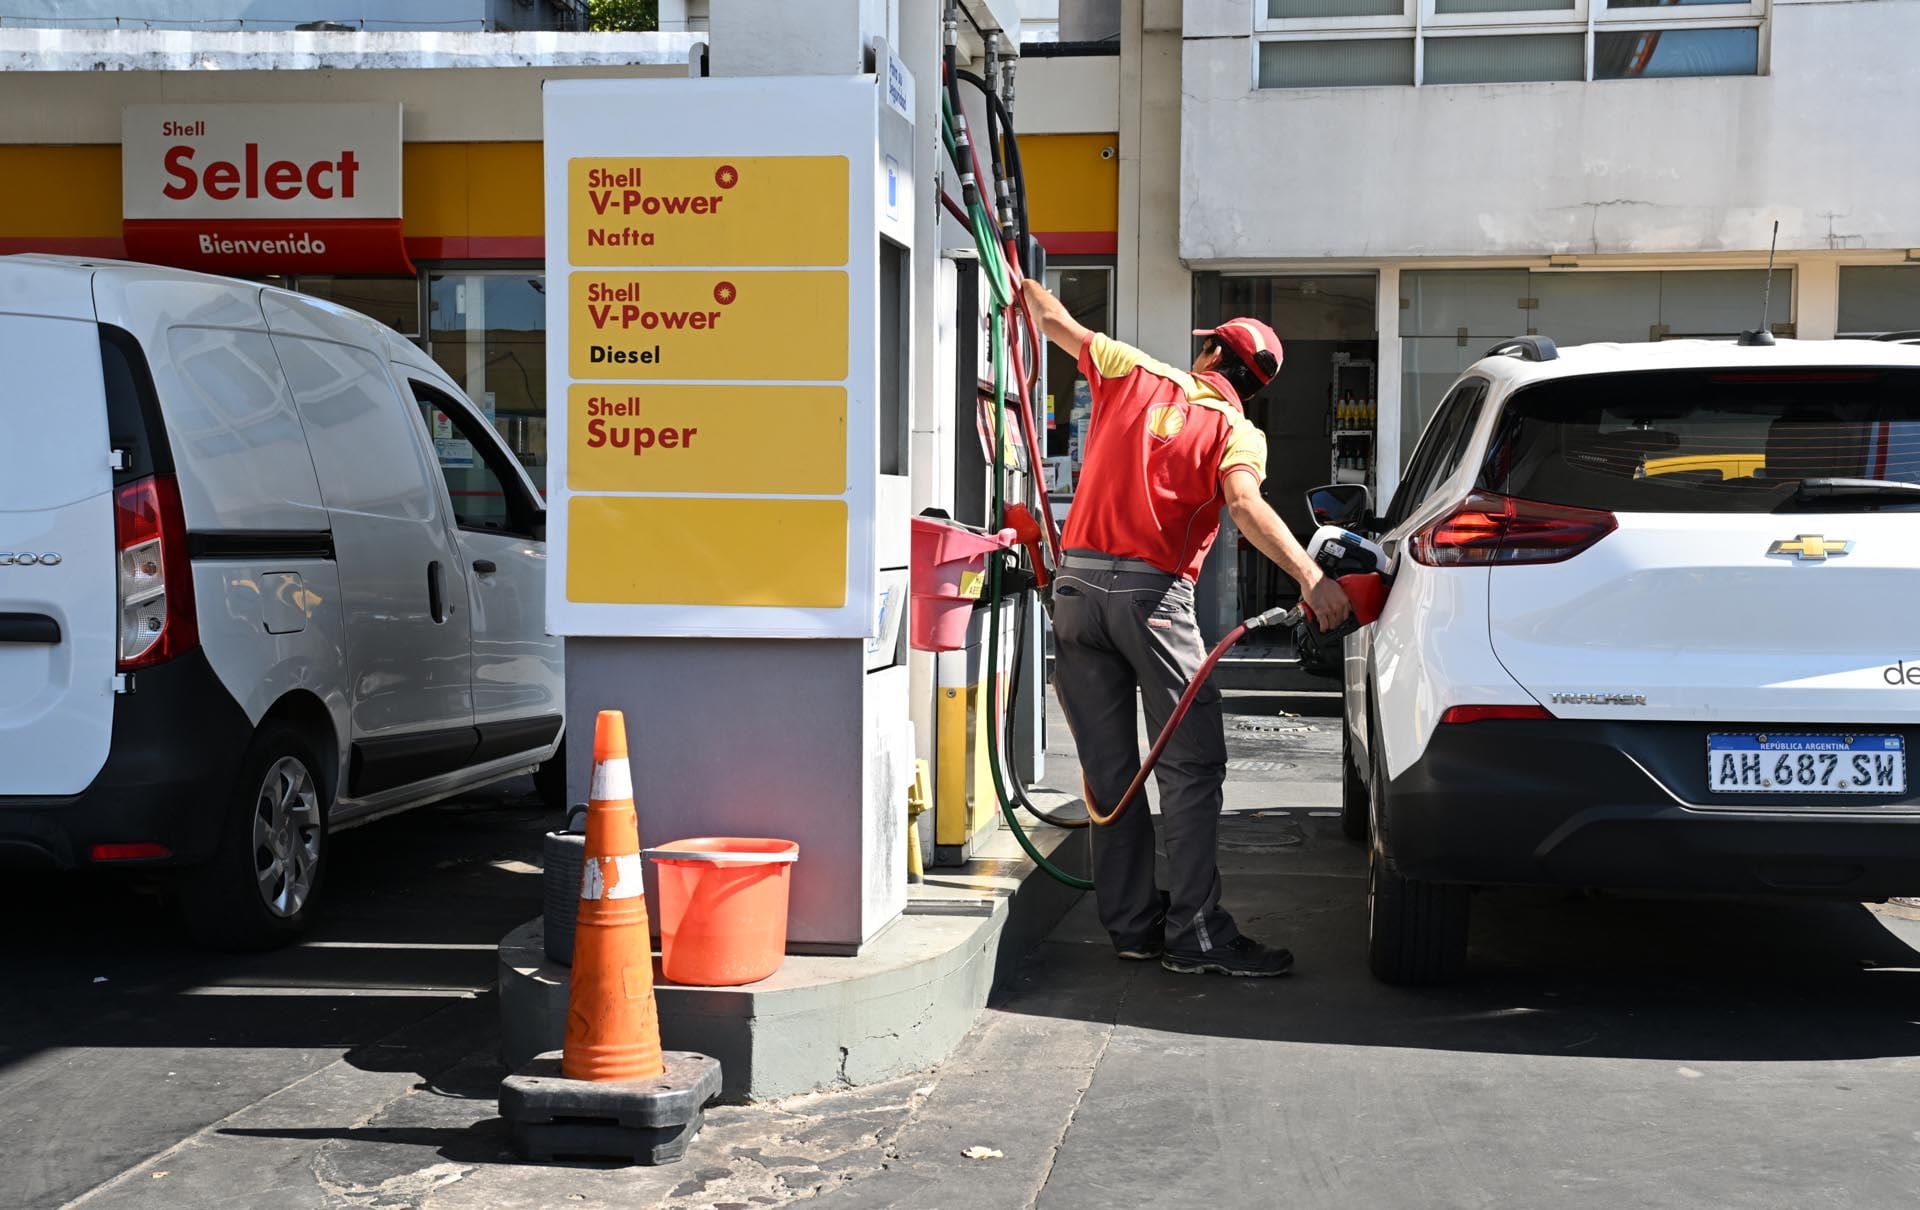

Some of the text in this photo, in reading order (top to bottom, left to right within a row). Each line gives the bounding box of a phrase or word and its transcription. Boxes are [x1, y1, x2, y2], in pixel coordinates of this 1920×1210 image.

[162, 121, 205, 136] Shell
[162, 143, 360, 200] Select
[587, 168, 641, 188] Shell
[588, 190, 723, 215] V-Power
[199, 233, 326, 254] Bienvenido
[588, 227, 655, 246] Nafta
[587, 282, 640, 302] Shell
[587, 304, 721, 329] V-Power
[590, 345, 660, 364] Diesel
[587, 397, 640, 416] Shell
[587, 418, 697, 456] Super
[1883, 659, 1920, 685] de
[1551, 691, 1647, 706] TRACKER
[1760, 740, 1850, 751] REPÚBLICA ARGENTINA
[1720, 753, 1894, 786] AH 687 SW
